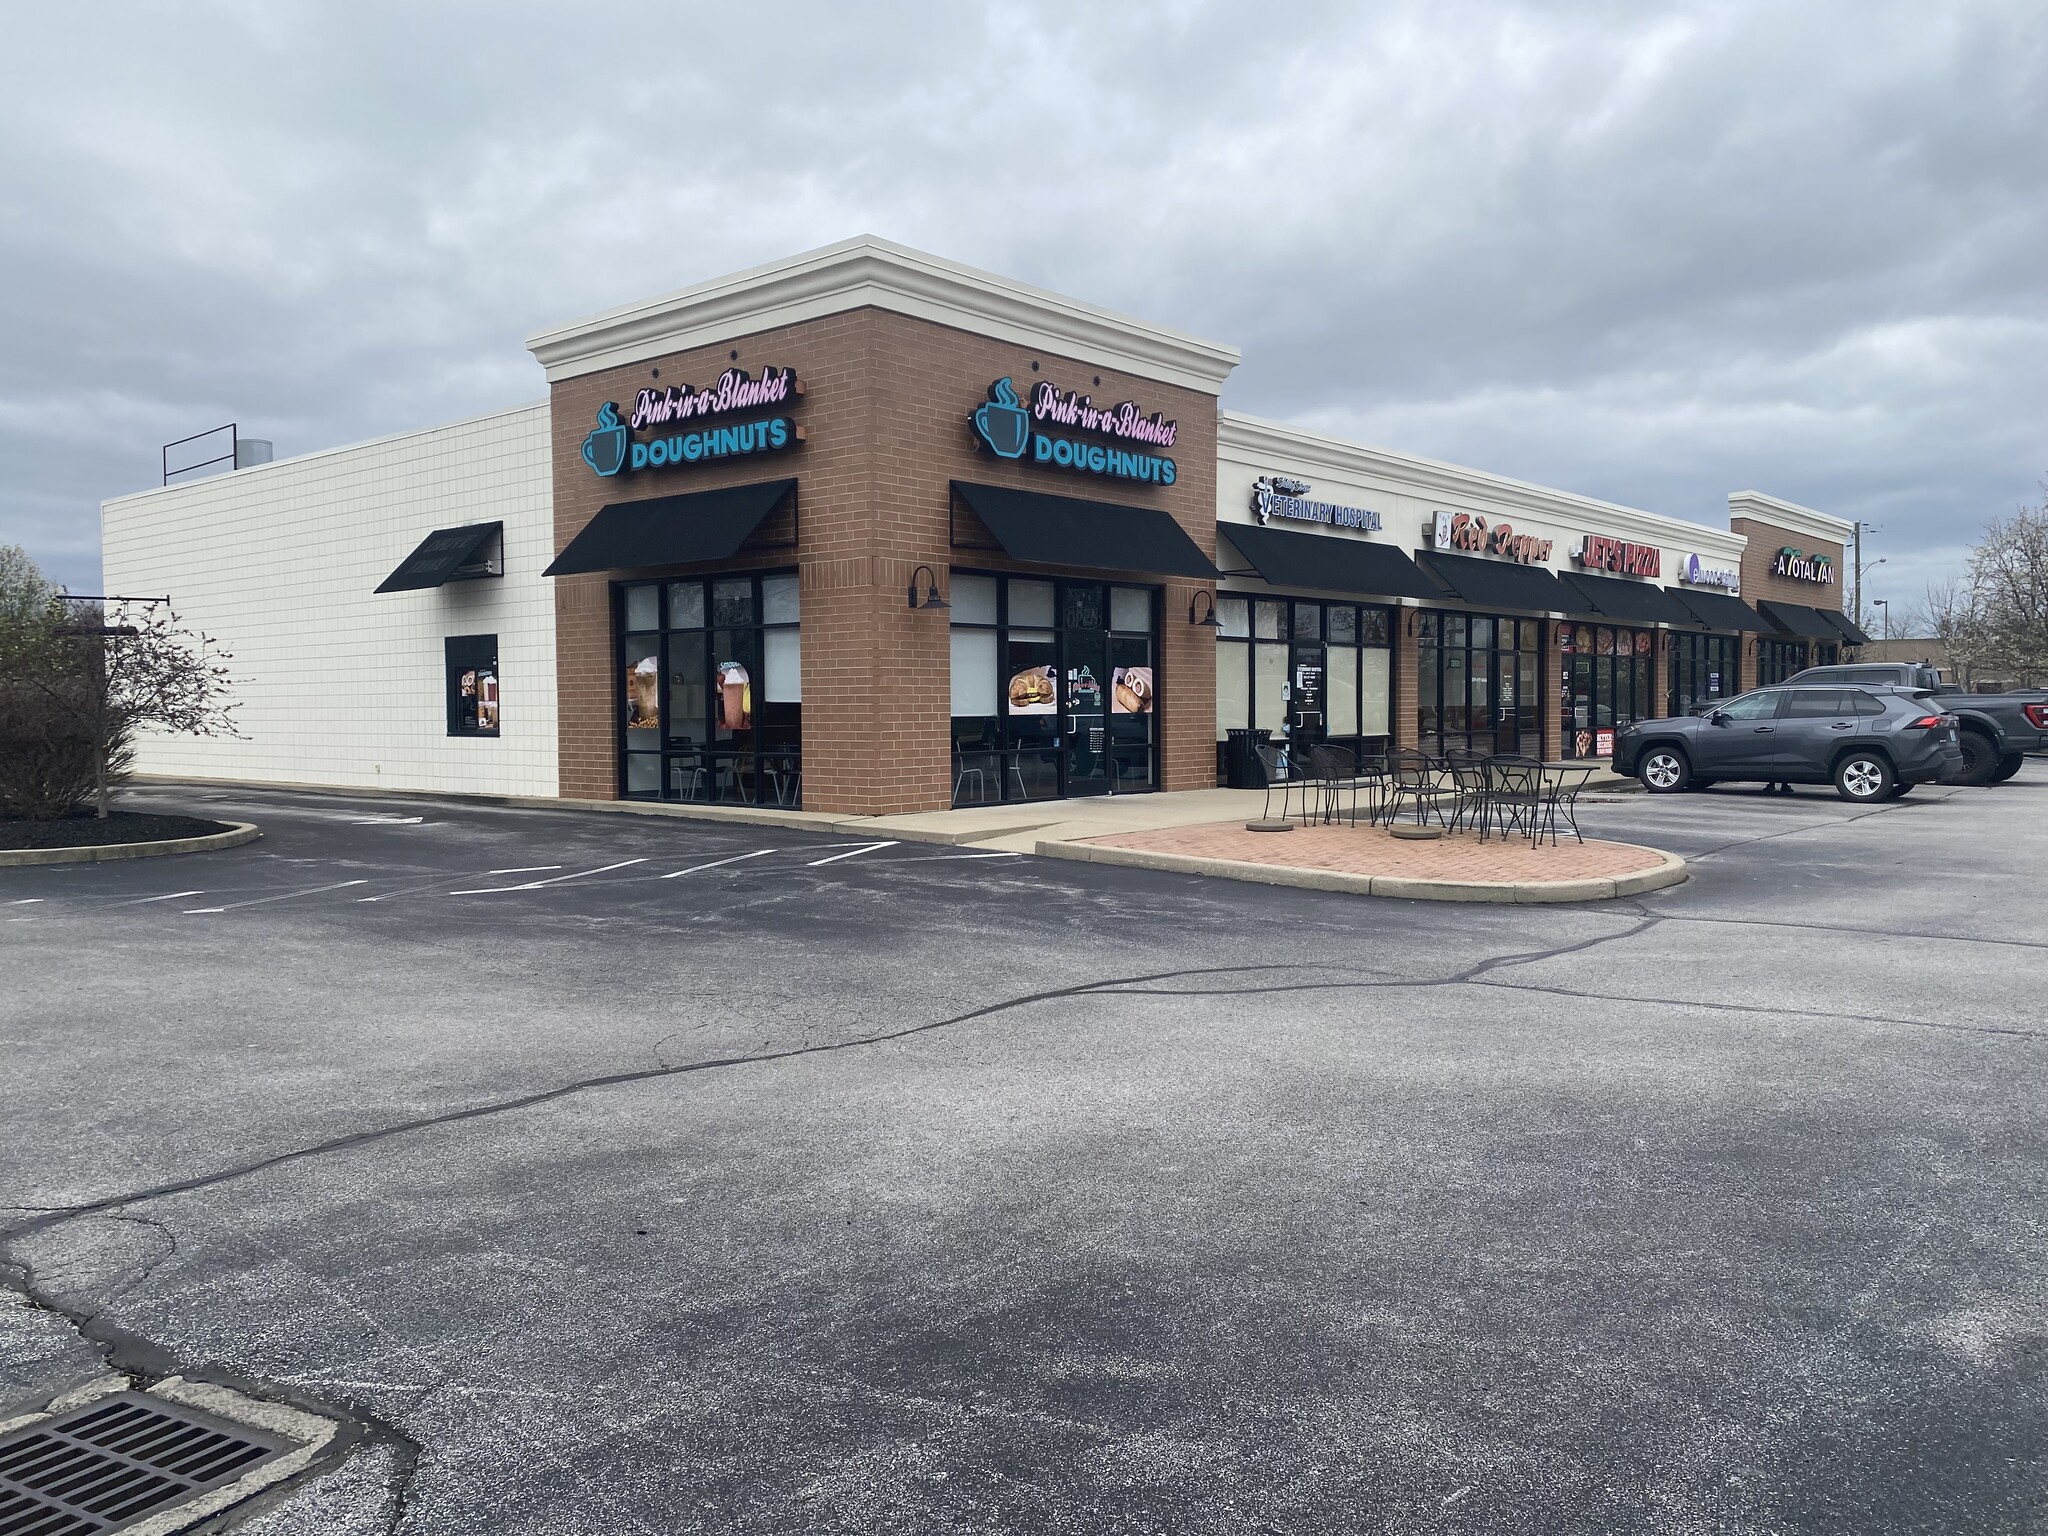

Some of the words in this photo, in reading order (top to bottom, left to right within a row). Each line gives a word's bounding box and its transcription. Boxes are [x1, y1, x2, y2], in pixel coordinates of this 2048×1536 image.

[631, 365, 788, 429] Pink-in-a-Blanket
[1034, 382, 1177, 447] Pink-in-a-Blanket
[631, 418, 788, 469] DOUGHNUTS
[1035, 434, 1177, 485] DOUGHNUTS
[1260, 491, 1334, 525] VETERINARY
[1334, 503, 1383, 532] HOSPITAL
[421, 533, 478, 554] DRIVE
[1452, 512, 1489, 552] Red
[1493, 523, 1554, 565] Pepper
[1583, 534, 1623, 573] JET'S
[1623, 542, 1661, 578] PIZZA
